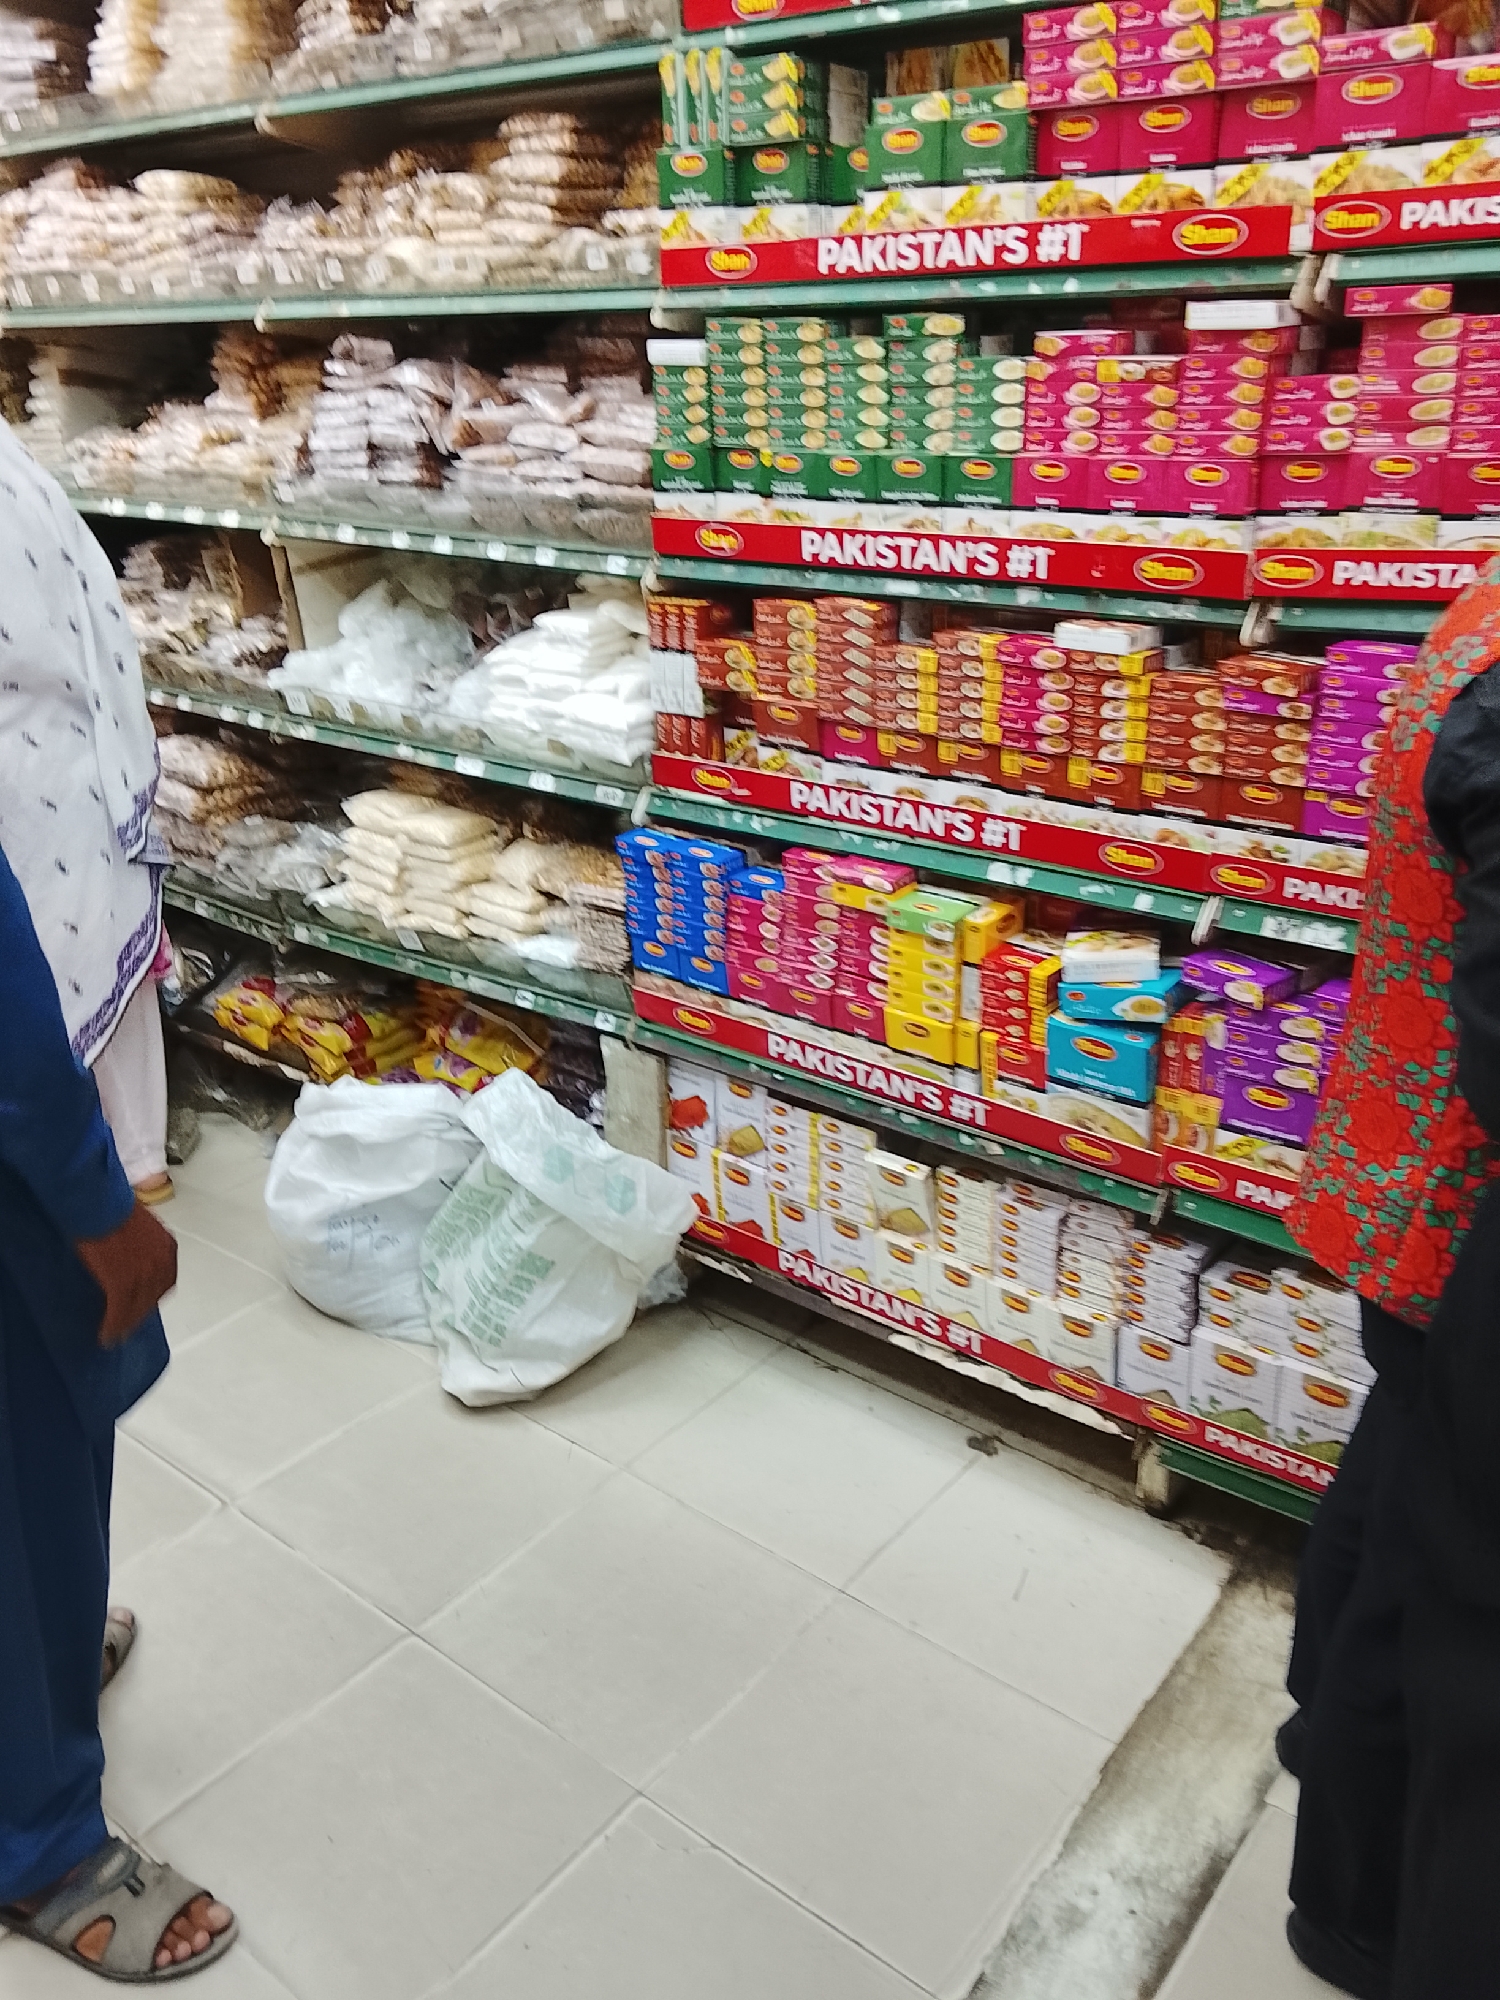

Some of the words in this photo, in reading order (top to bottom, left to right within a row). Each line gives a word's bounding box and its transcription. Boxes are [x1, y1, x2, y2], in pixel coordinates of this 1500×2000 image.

[1180, 223, 1239, 246] Shan
[1324, 209, 1381, 230] Shan
[816, 225, 1029, 275] PAKISTAN'S
[801, 529, 999, 577] PAKISTAN'S
[1141, 559, 1194, 581] Shan
[790, 782, 975, 843] PAKISTAN'S
[1283, 877, 1365, 911] PAKI
[764, 1033, 943, 1112] PAKISTAN'S
[778, 1250, 942, 1336] PAKISTAN'S
